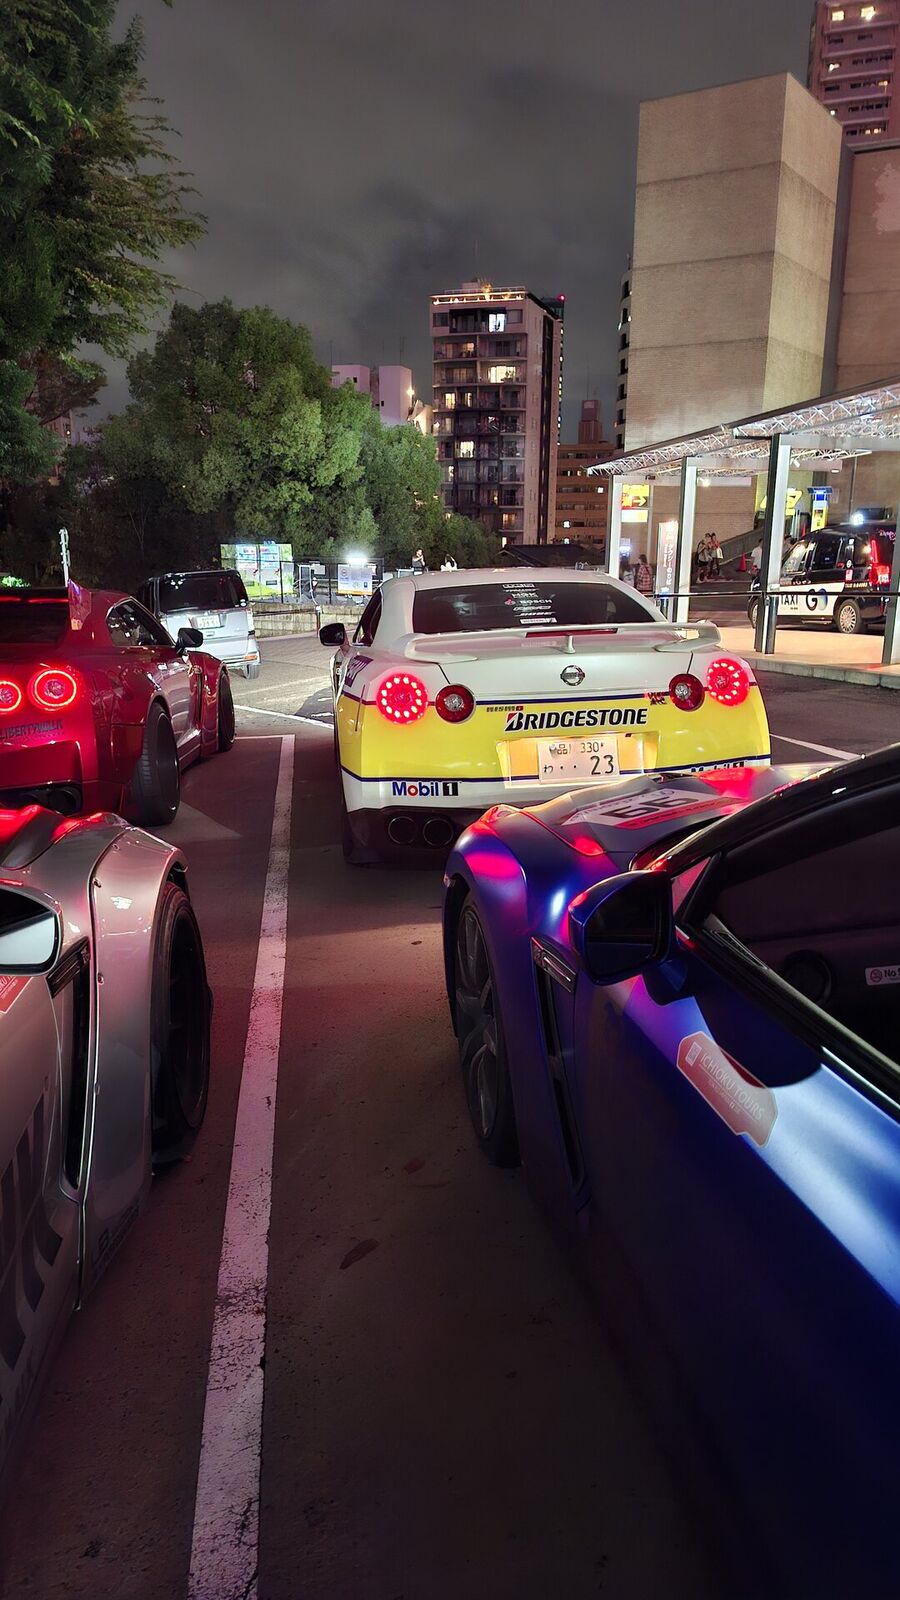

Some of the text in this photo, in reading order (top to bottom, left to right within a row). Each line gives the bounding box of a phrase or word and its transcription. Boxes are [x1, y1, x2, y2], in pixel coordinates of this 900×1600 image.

[504, 708, 648, 732] BRIDGESTONE
[580, 741, 600, 754] 330
[590, 754, 614, 776] 23
[392, 781, 439, 797] Mobil
[700, 1053, 737, 1090] ICHIOKU
[732, 1087, 766, 1120] TOURS
